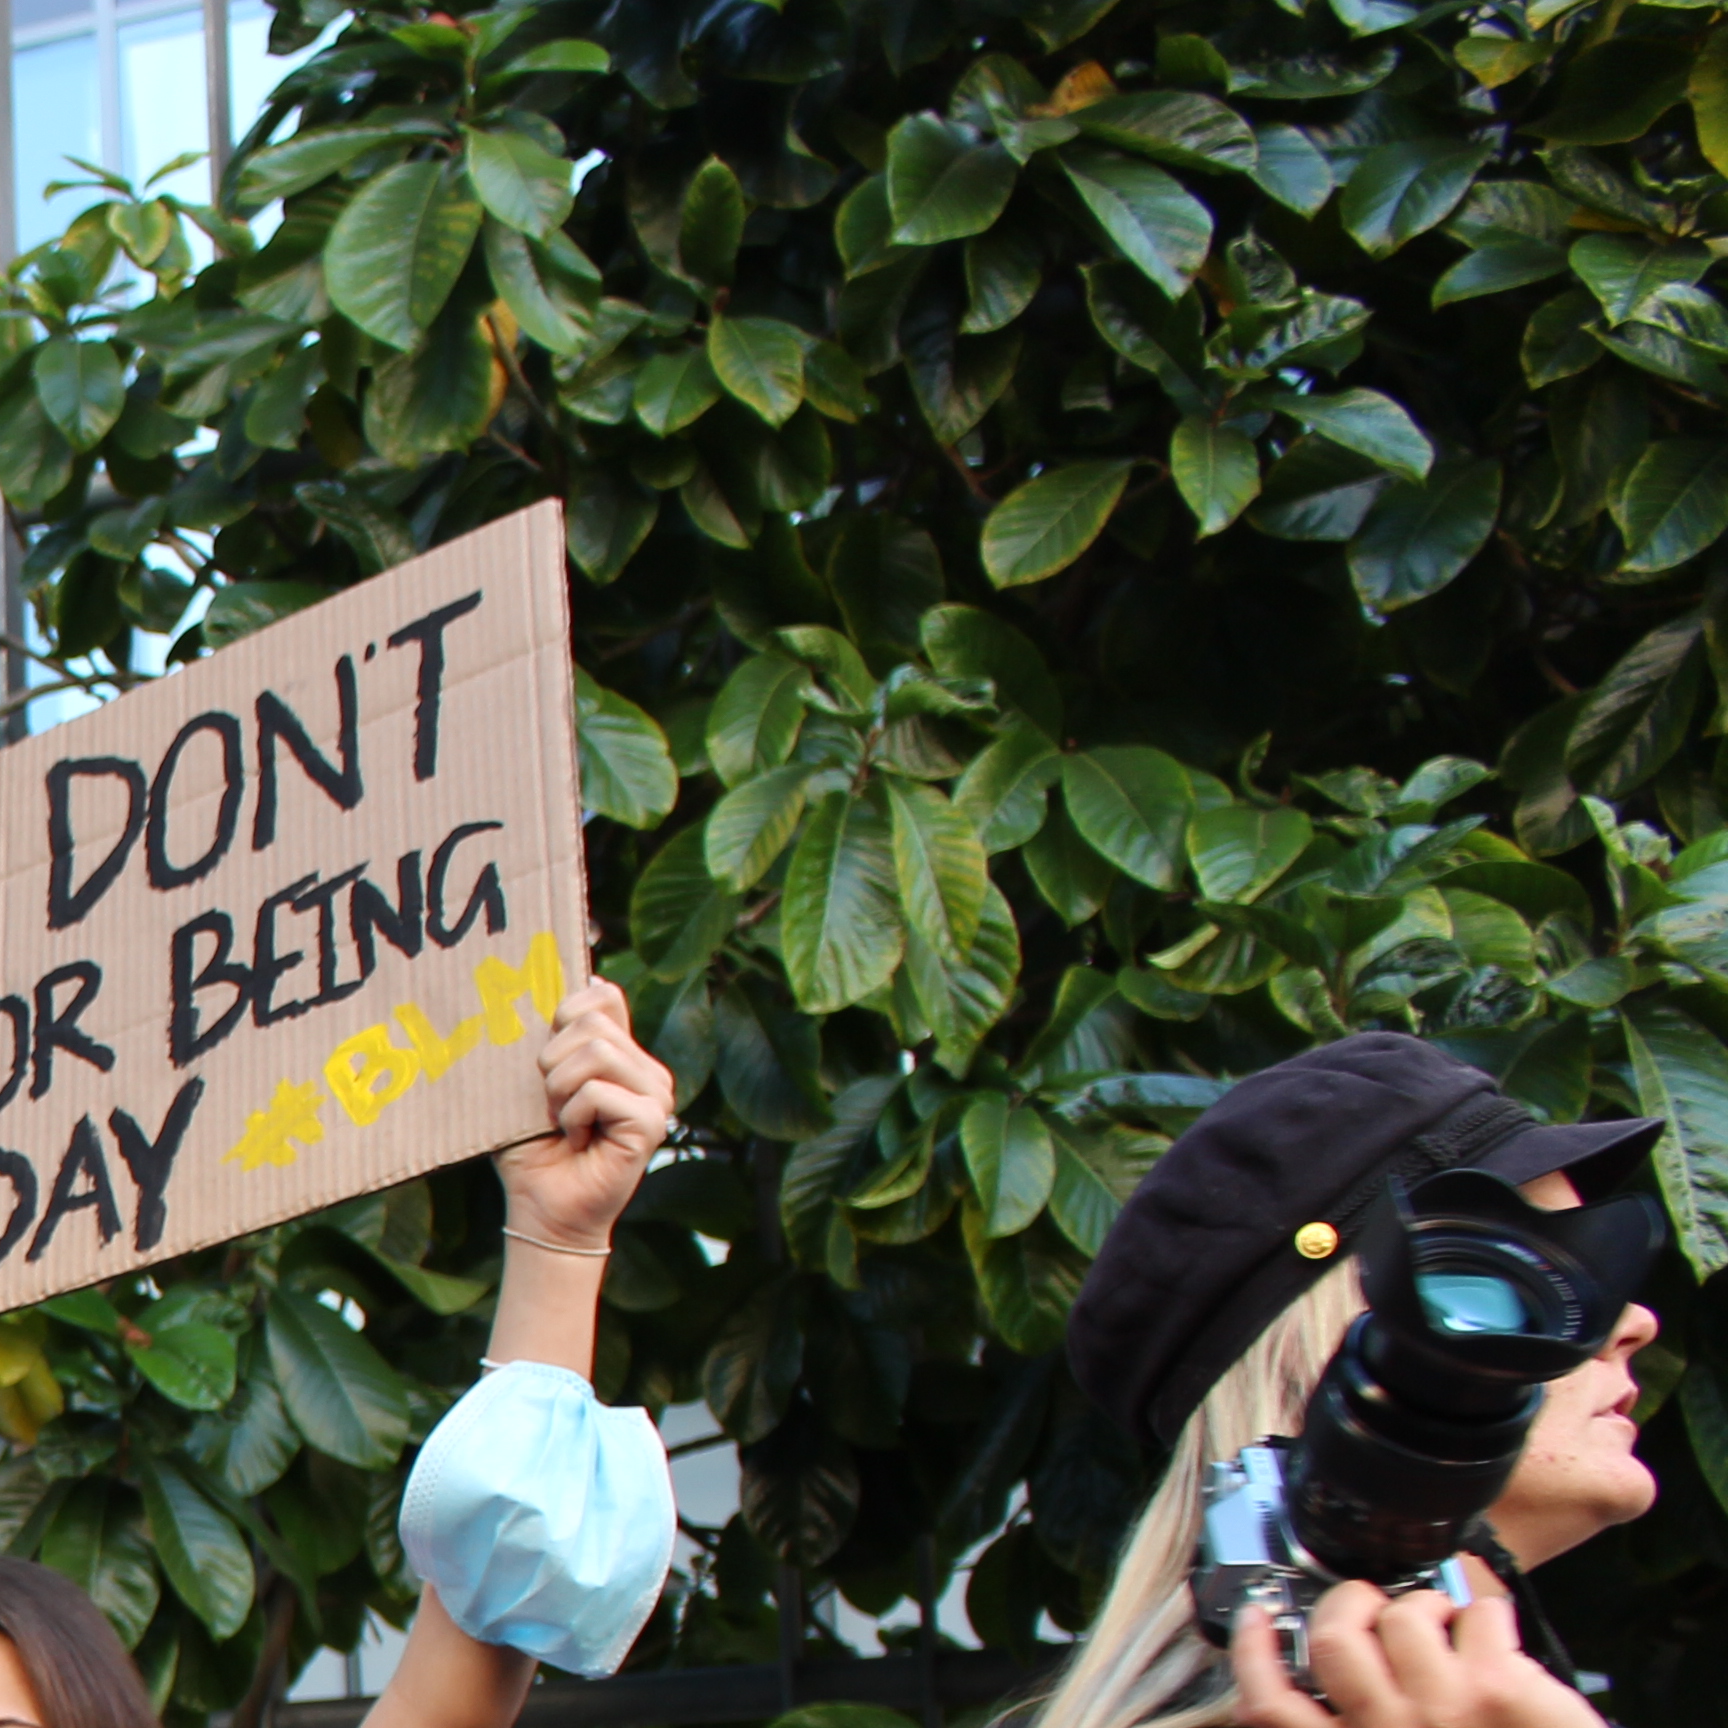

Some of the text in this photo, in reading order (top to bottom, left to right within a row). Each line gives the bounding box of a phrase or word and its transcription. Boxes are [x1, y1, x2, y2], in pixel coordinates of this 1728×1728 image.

[45, 588, 483, 932] DON'T
[167, 820, 508, 1071] BEING
[219, 931, 566, 1173] #BLM
